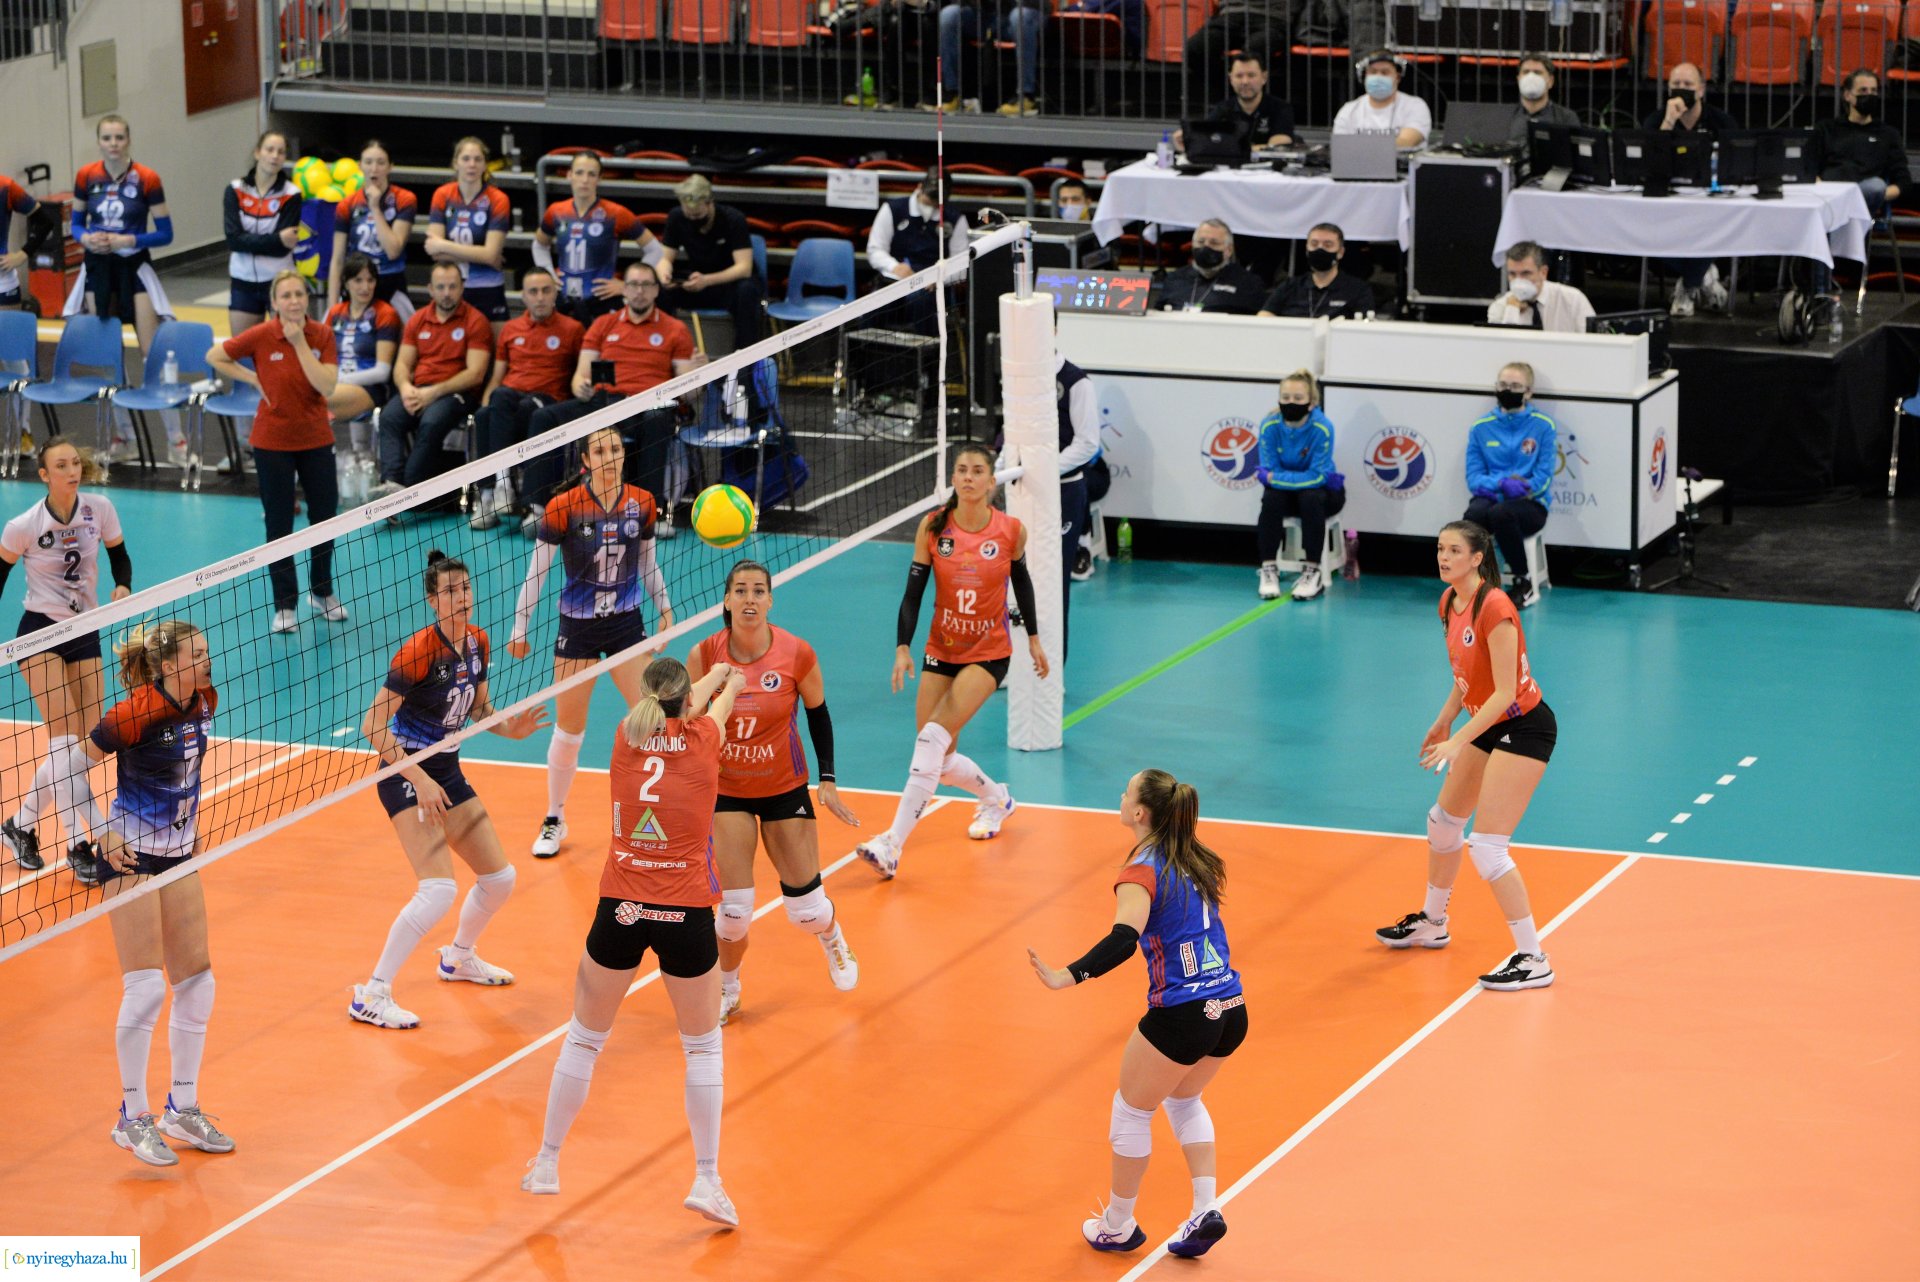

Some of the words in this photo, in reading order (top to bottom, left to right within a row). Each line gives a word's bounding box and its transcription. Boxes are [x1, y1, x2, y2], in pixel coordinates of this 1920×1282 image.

[96, 201, 124, 228] 12
[565, 239, 587, 270] 11
[1219, 418, 1254, 429] FATUM
[1382, 428, 1418, 438] FATUM
[1554, 491, 1598, 506] ABDA
[63, 550, 82, 581] 2
[594, 545, 626, 583] 17
[957, 589, 977, 615] 12
[942, 608, 995, 632] FATUM
[443, 684, 475, 728] 20
[735, 717, 757, 739] 17
[640, 733, 687, 752] DONJIĆ
[722, 743, 775, 759] ATUM
[639, 756, 665, 802] 2
[632, 859, 687, 868] BESTRONG
[641, 911, 685, 922] REVESZ
[1183, 943, 1194, 975] STRABAG
